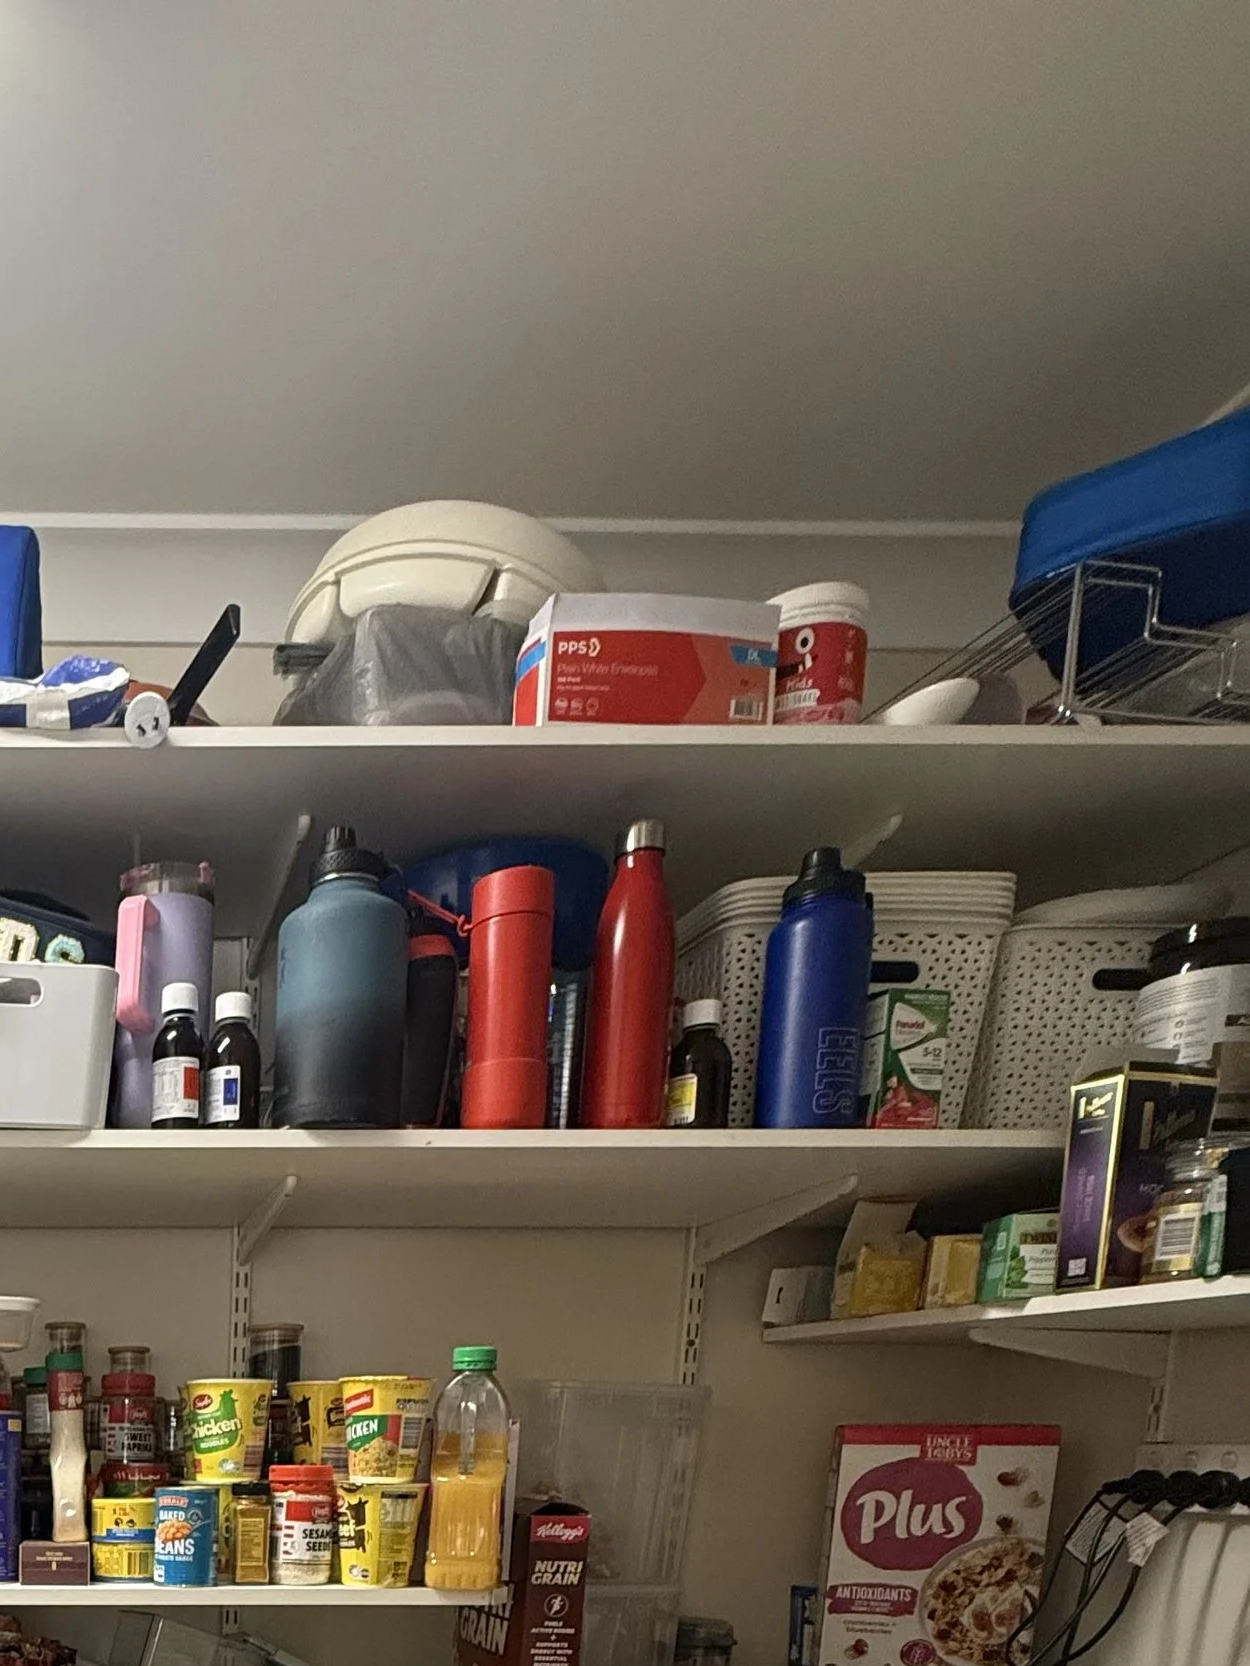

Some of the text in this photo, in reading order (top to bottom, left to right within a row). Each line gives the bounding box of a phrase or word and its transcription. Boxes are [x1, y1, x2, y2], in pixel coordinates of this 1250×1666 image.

[558, 641, 587, 655] PPS
[582, 663, 610, 675] White
[812, 1026, 861, 1115] EELS
[925, 1434, 972, 1448] UNCLE
[158, 1510, 186, 1521] BAKED
[855, 1488, 967, 1545] Plus
[536, 1522, 585, 1540] Kellogg's
[534, 1560, 584, 1573] NUTRI
[531, 1572, 581, 1586] GRAIN
[835, 1587, 912, 1602] ANTIOXIDANTS
[843, 1619, 892, 1628] cranberries
[459, 1606, 508, 1656] GRAIN
[845, 1627, 893, 1635] blueberries
[533, 1655, 568, 1663] ESSENTIAL
